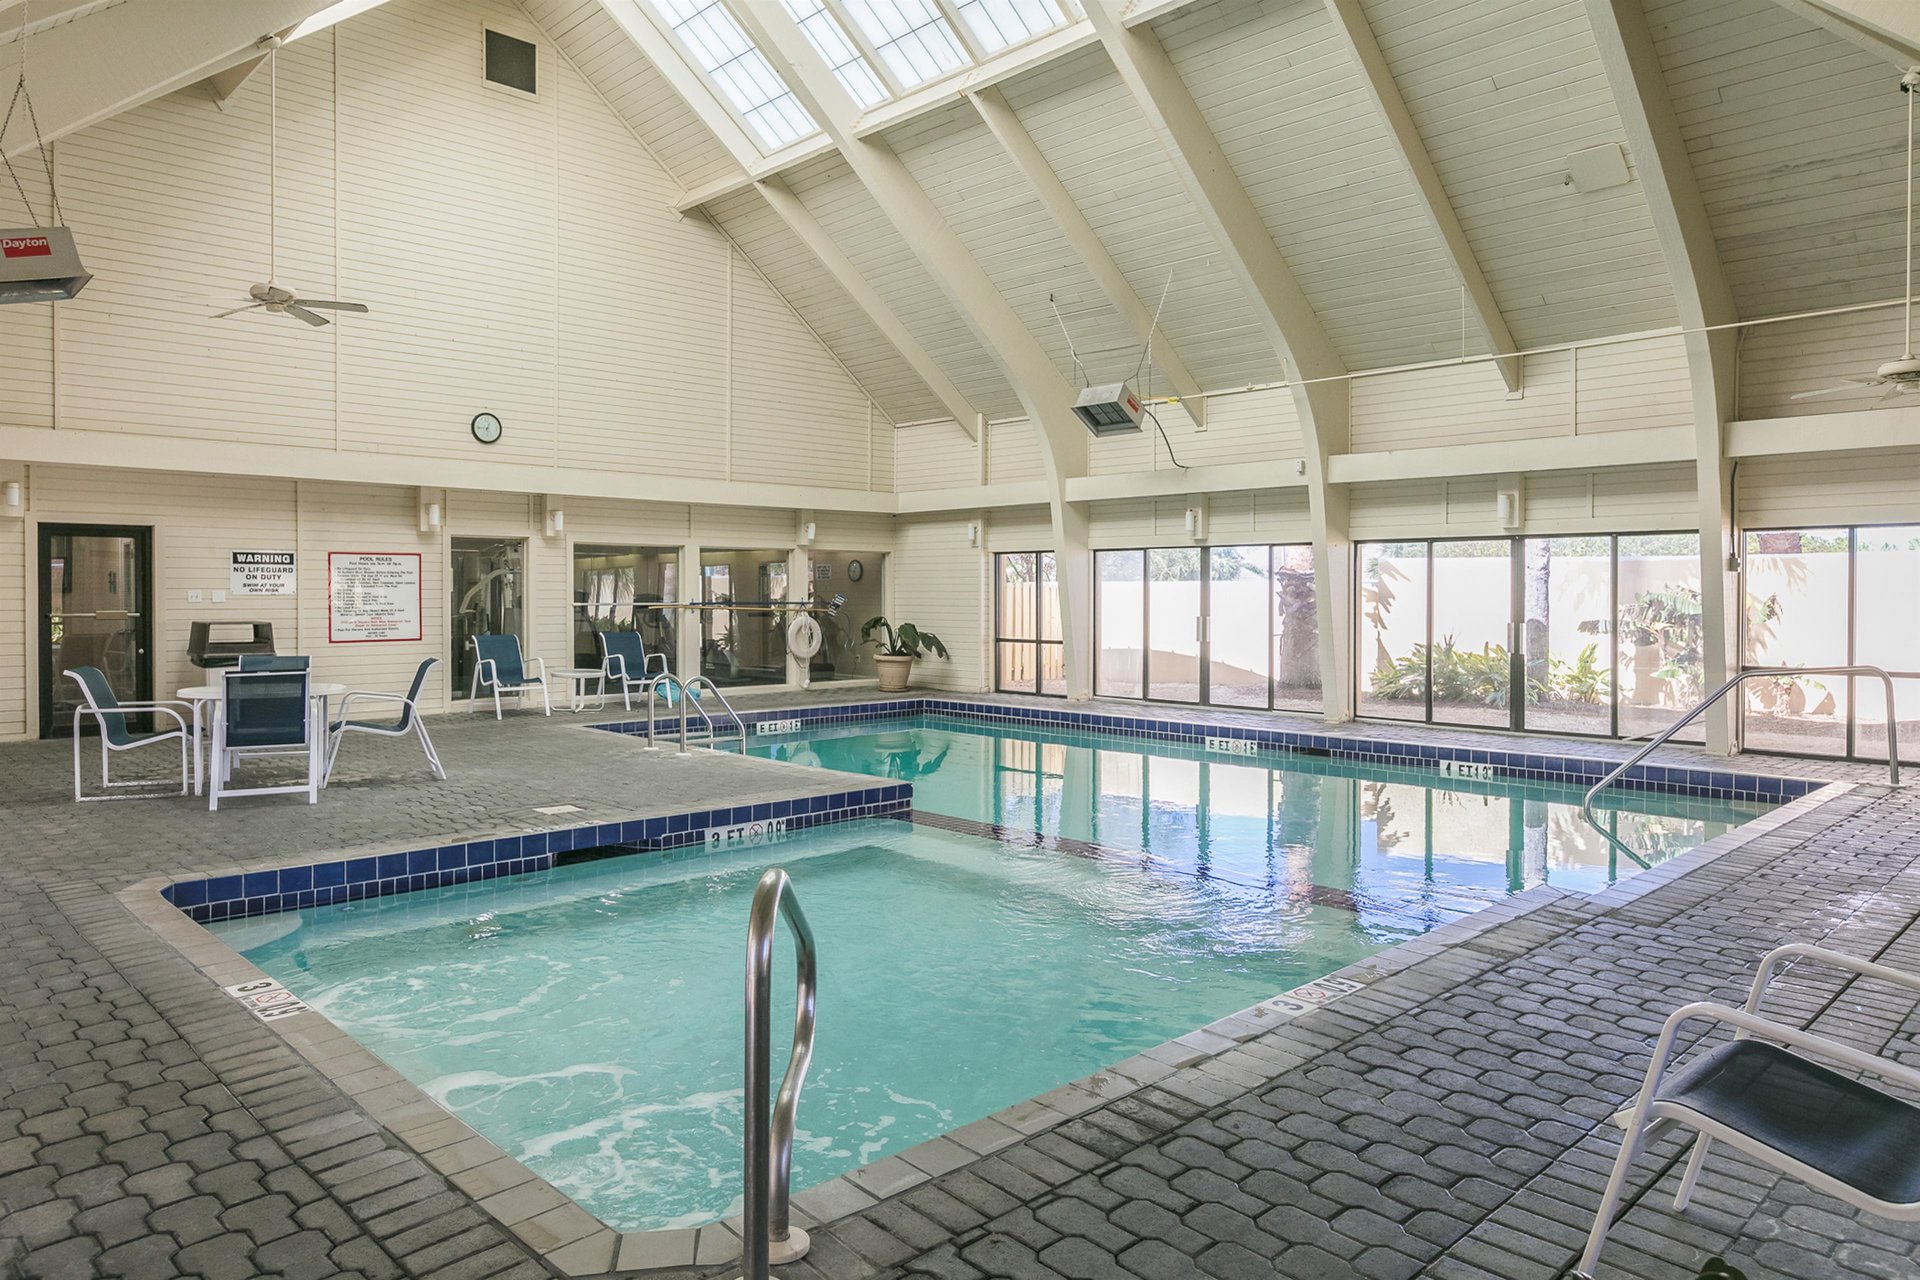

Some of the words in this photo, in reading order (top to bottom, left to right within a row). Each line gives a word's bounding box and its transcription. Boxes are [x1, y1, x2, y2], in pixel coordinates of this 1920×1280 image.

[2, 238, 47, 250] Dayton
[236, 553, 291, 563] WARNING
[237, 982, 272, 992] 3
[1272, 1000, 1304, 1010] 3
